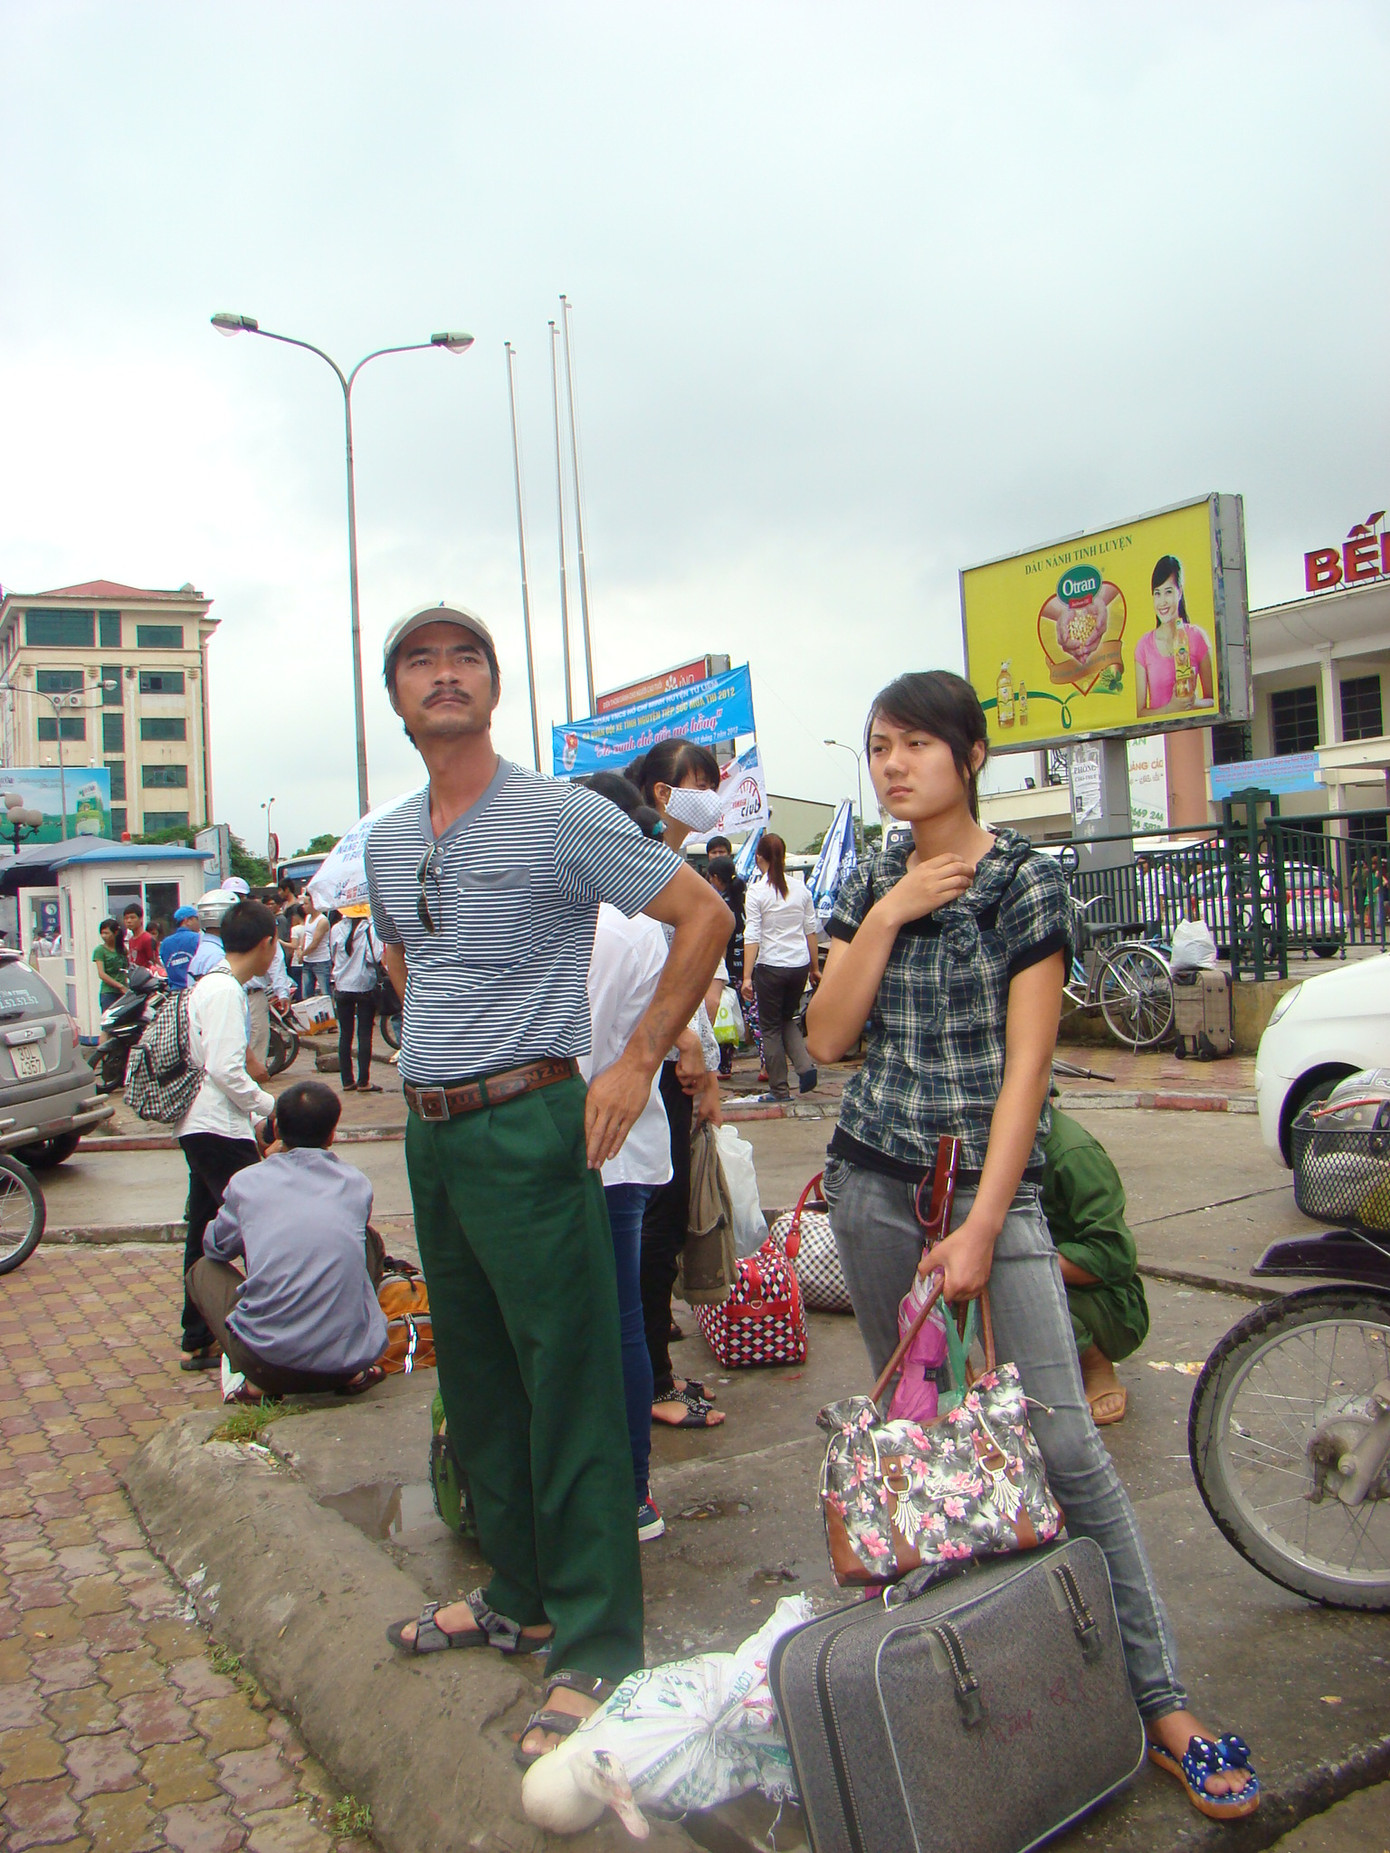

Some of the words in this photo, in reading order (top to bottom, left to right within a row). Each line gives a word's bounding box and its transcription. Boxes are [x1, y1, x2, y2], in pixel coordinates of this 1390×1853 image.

[1073, 544, 1097, 561] TINH
[1099, 534, 1133, 553] LUYỆN
[1062, 577, 1097, 596] Otran
[718, 686, 735, 701] 2012
[741, 799, 761, 817] club
[18, 1046, 36, 1060] 30L
[22, 1060, 41, 1075] 4357
